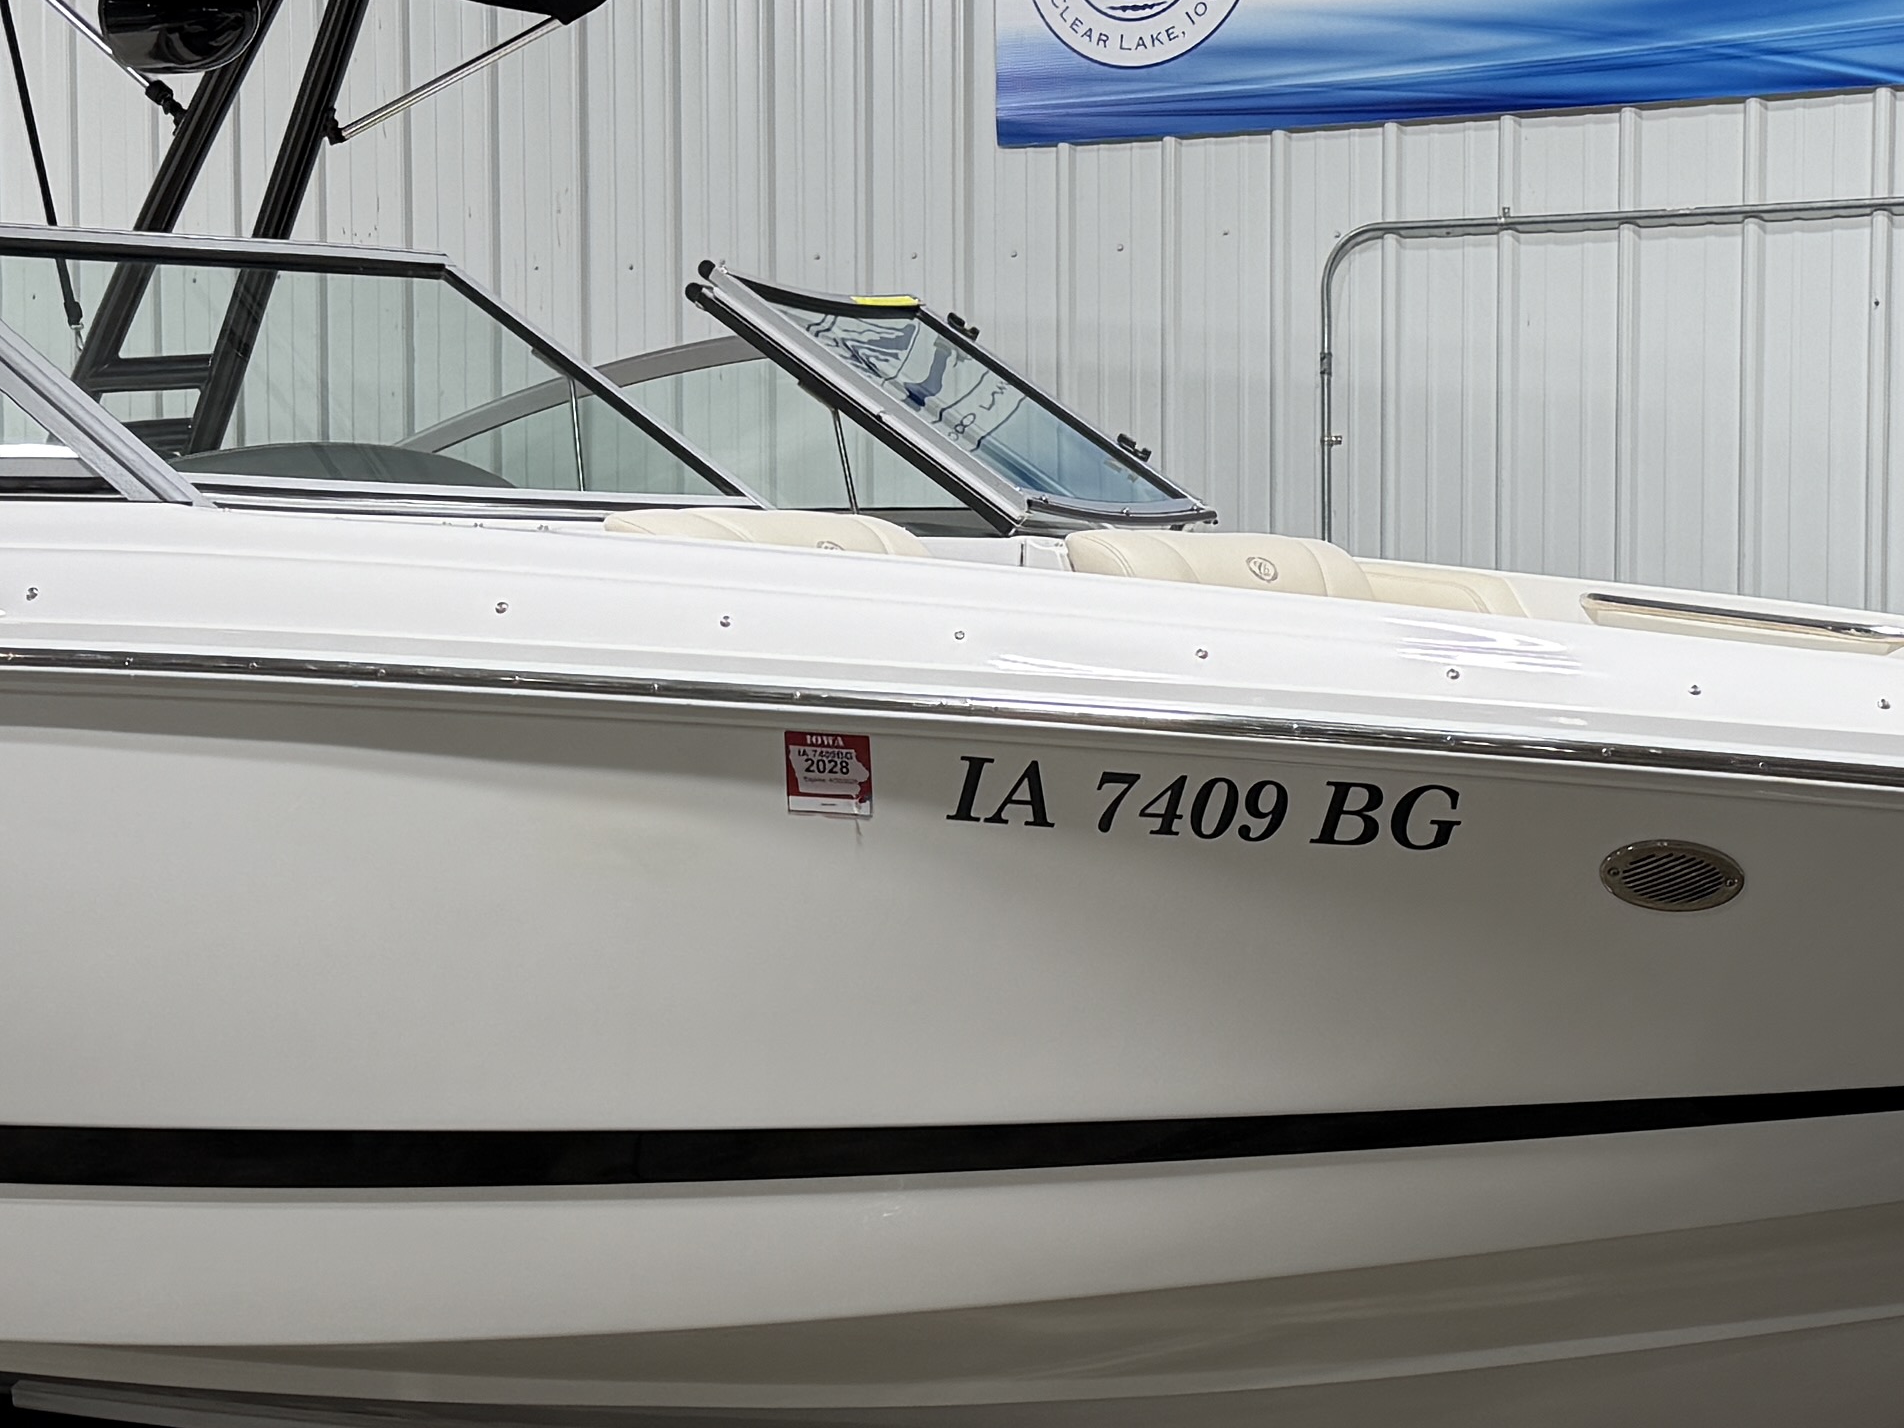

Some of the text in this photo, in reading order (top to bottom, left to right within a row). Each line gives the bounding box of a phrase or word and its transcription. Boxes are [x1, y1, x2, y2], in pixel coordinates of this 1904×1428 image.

[1119, 25, 1187, 51] LAKE,
[805, 734, 845, 747] IOWA
[798, 748, 809, 758] IA
[804, 758, 850, 776] 2028
[945, 755, 1463, 851] IA 7409 BG
